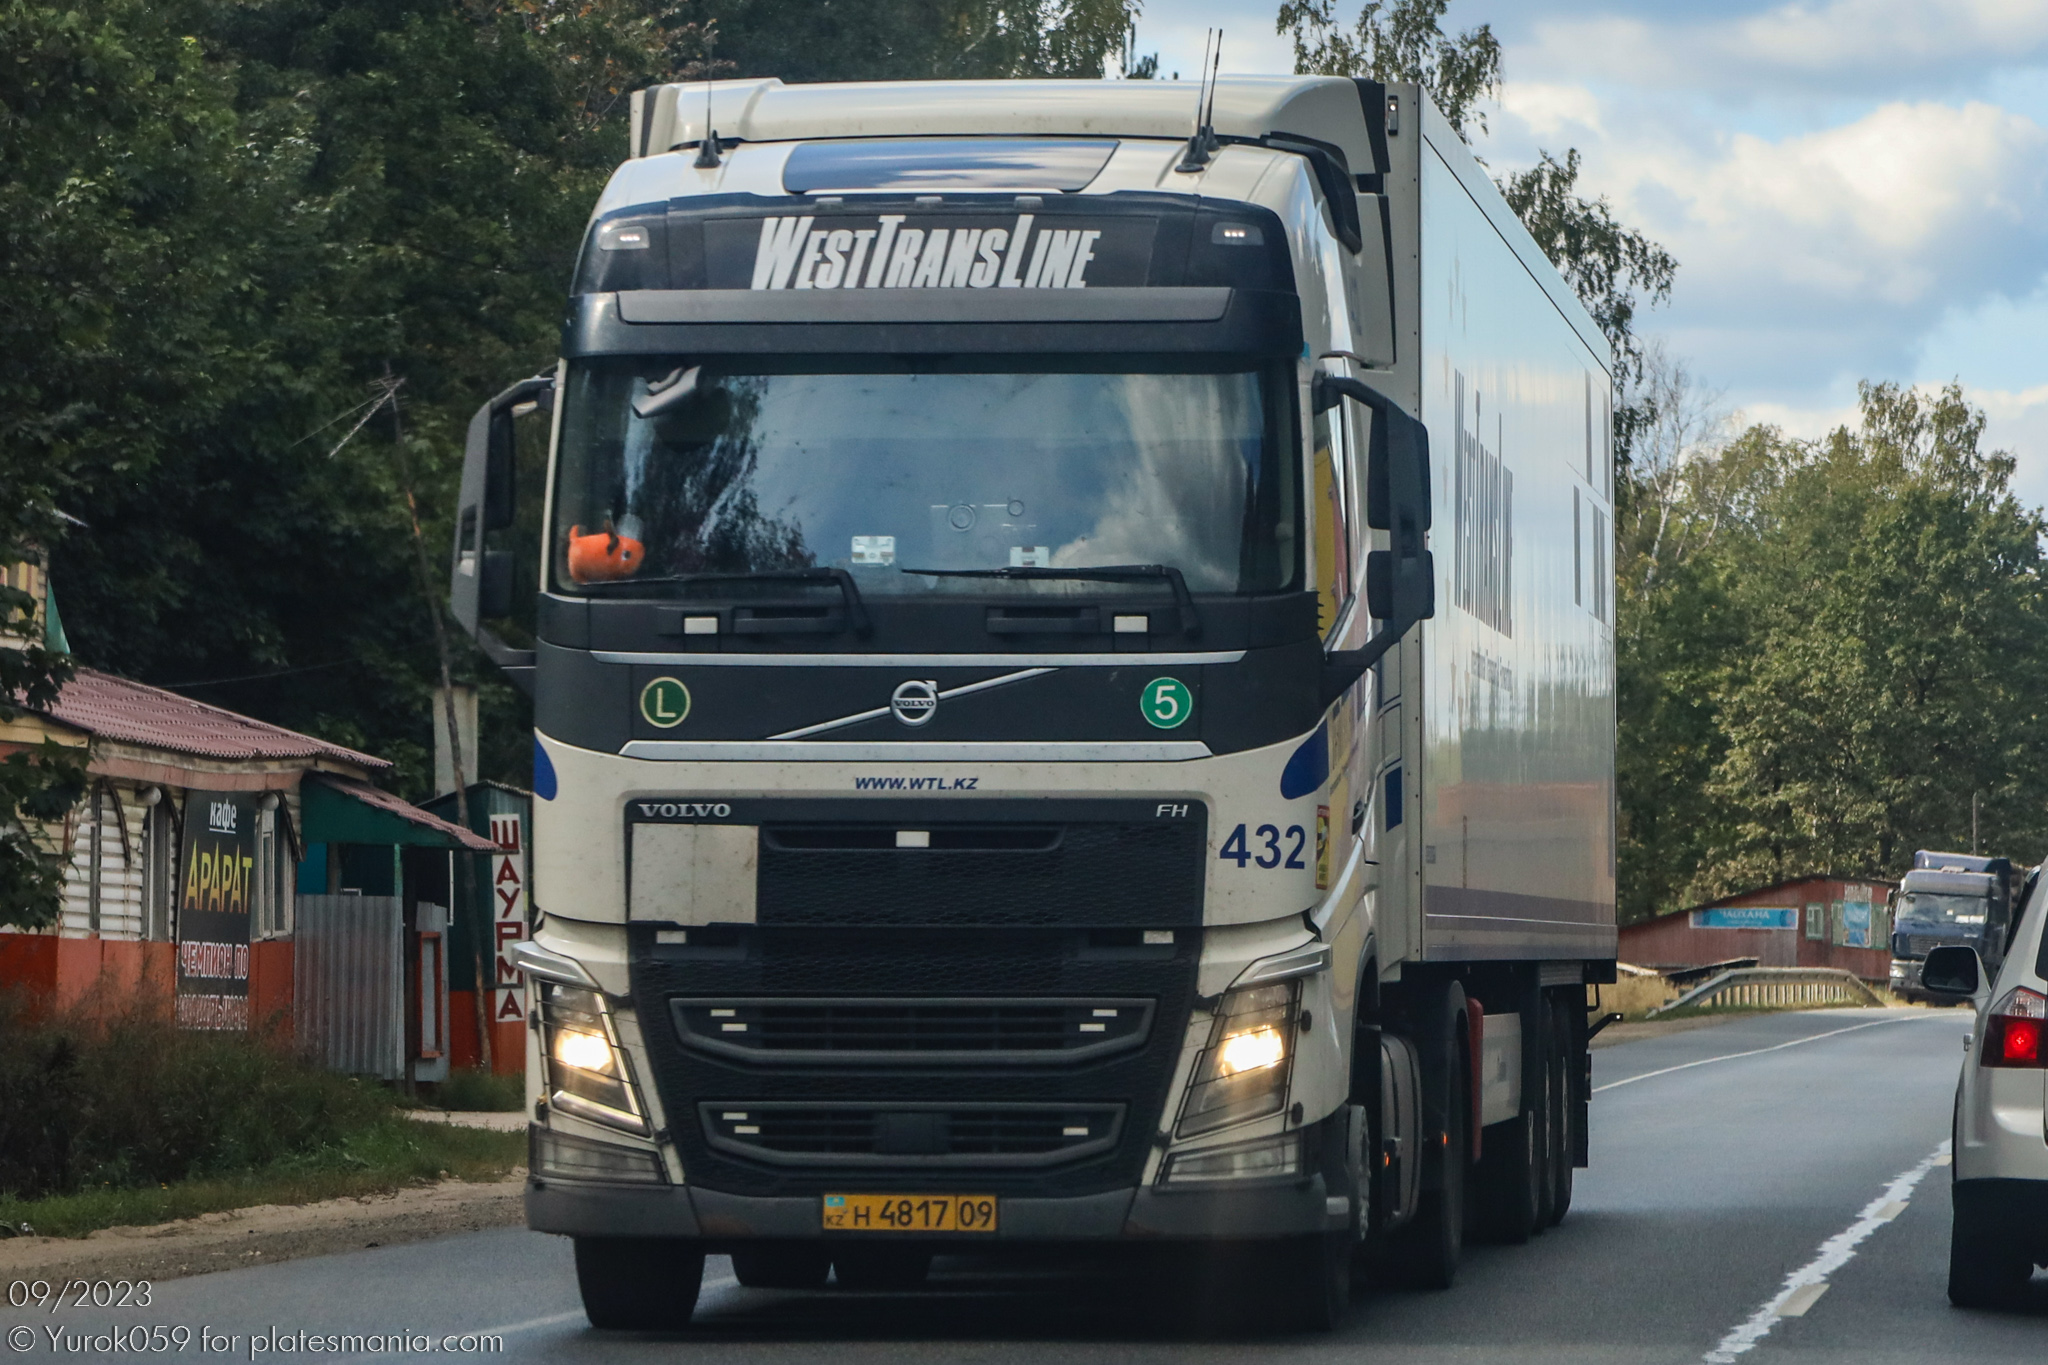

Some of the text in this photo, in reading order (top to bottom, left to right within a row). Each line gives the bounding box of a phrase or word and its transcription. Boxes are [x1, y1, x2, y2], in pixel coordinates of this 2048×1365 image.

[656, 687, 677, 718] L
[893, 699, 936, 708] VOLVO
[1154, 685, 1179, 720] 5
[855, 776, 980, 791] WWW.WTL.KZ
[209, 799, 237, 832] кафе
[638, 803, 731, 818] VOLVO
[1156, 804, 1189, 818] FH
[1219, 823, 1306, 869] 432
[184, 838, 253, 914] АРАРАТ
[491, 820, 523, 1019] ШАУРМА
[181, 940, 249, 980] ЧЕМПИОН ПО
[825, 1214, 844, 1226] KZ
[879, 1200, 949, 1227] 4817
[960, 1201, 993, 1227] 09
